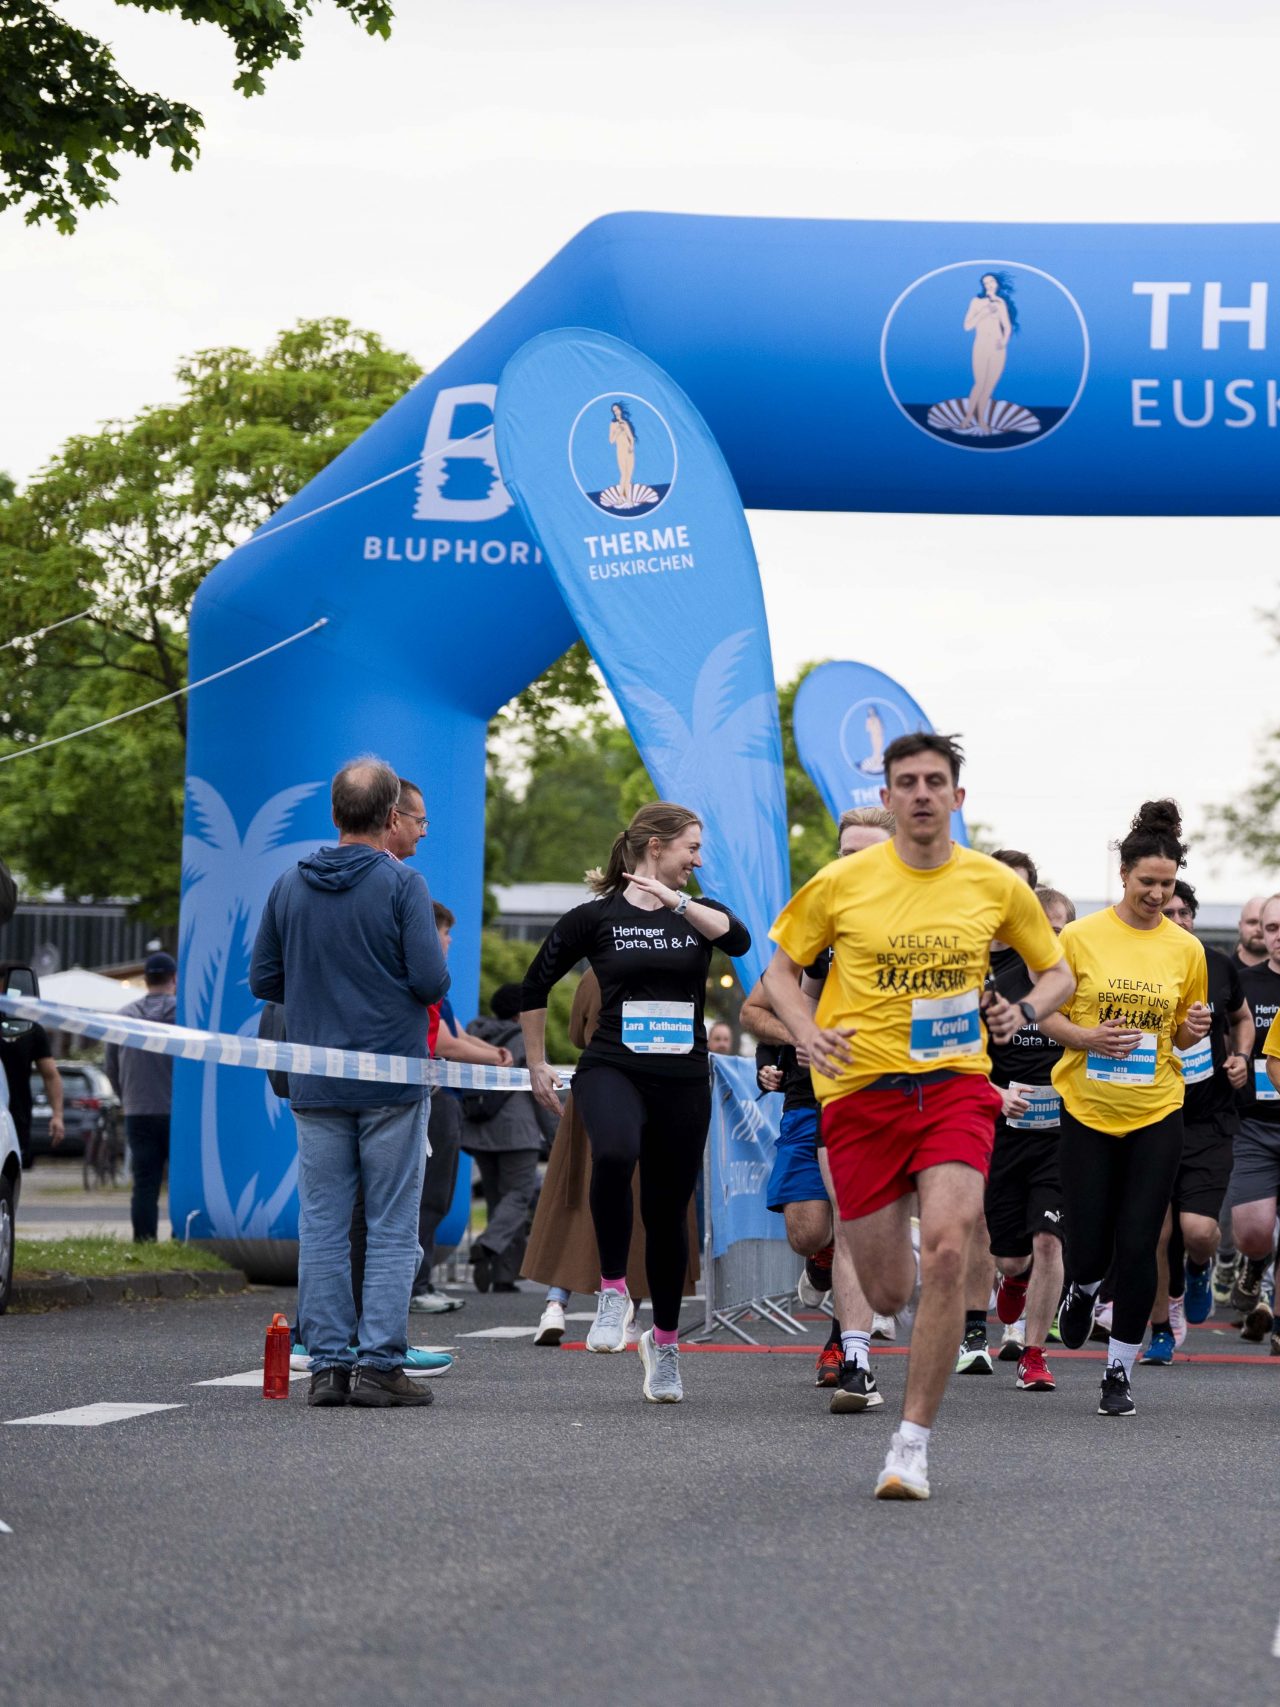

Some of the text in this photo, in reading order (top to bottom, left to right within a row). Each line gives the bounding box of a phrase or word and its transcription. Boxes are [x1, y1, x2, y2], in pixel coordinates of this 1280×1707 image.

[583, 525, 690, 558] THERME
[363, 536, 542, 564] BLUPHORI
[588, 553, 694, 580] EUSKIRCHEN
[612, 926, 664, 938] Heringer
[615, 939, 652, 951] Data,
[653, 938, 668, 949] BI
[671, 937, 683, 949] &
[888, 935, 960, 949] VIELFALT
[877, 952, 969, 966] BEWEGT UNS
[1108, 979, 1163, 994] VIELFALT
[1098, 992, 1170, 1010] BEWEGT UNS
[1255, 1004, 1280, 1014] Herin
[624, 1021, 692, 1032] Lara Katharina
[932, 1018, 969, 1037] Kevin
[1026, 1100, 1060, 1112] annik
